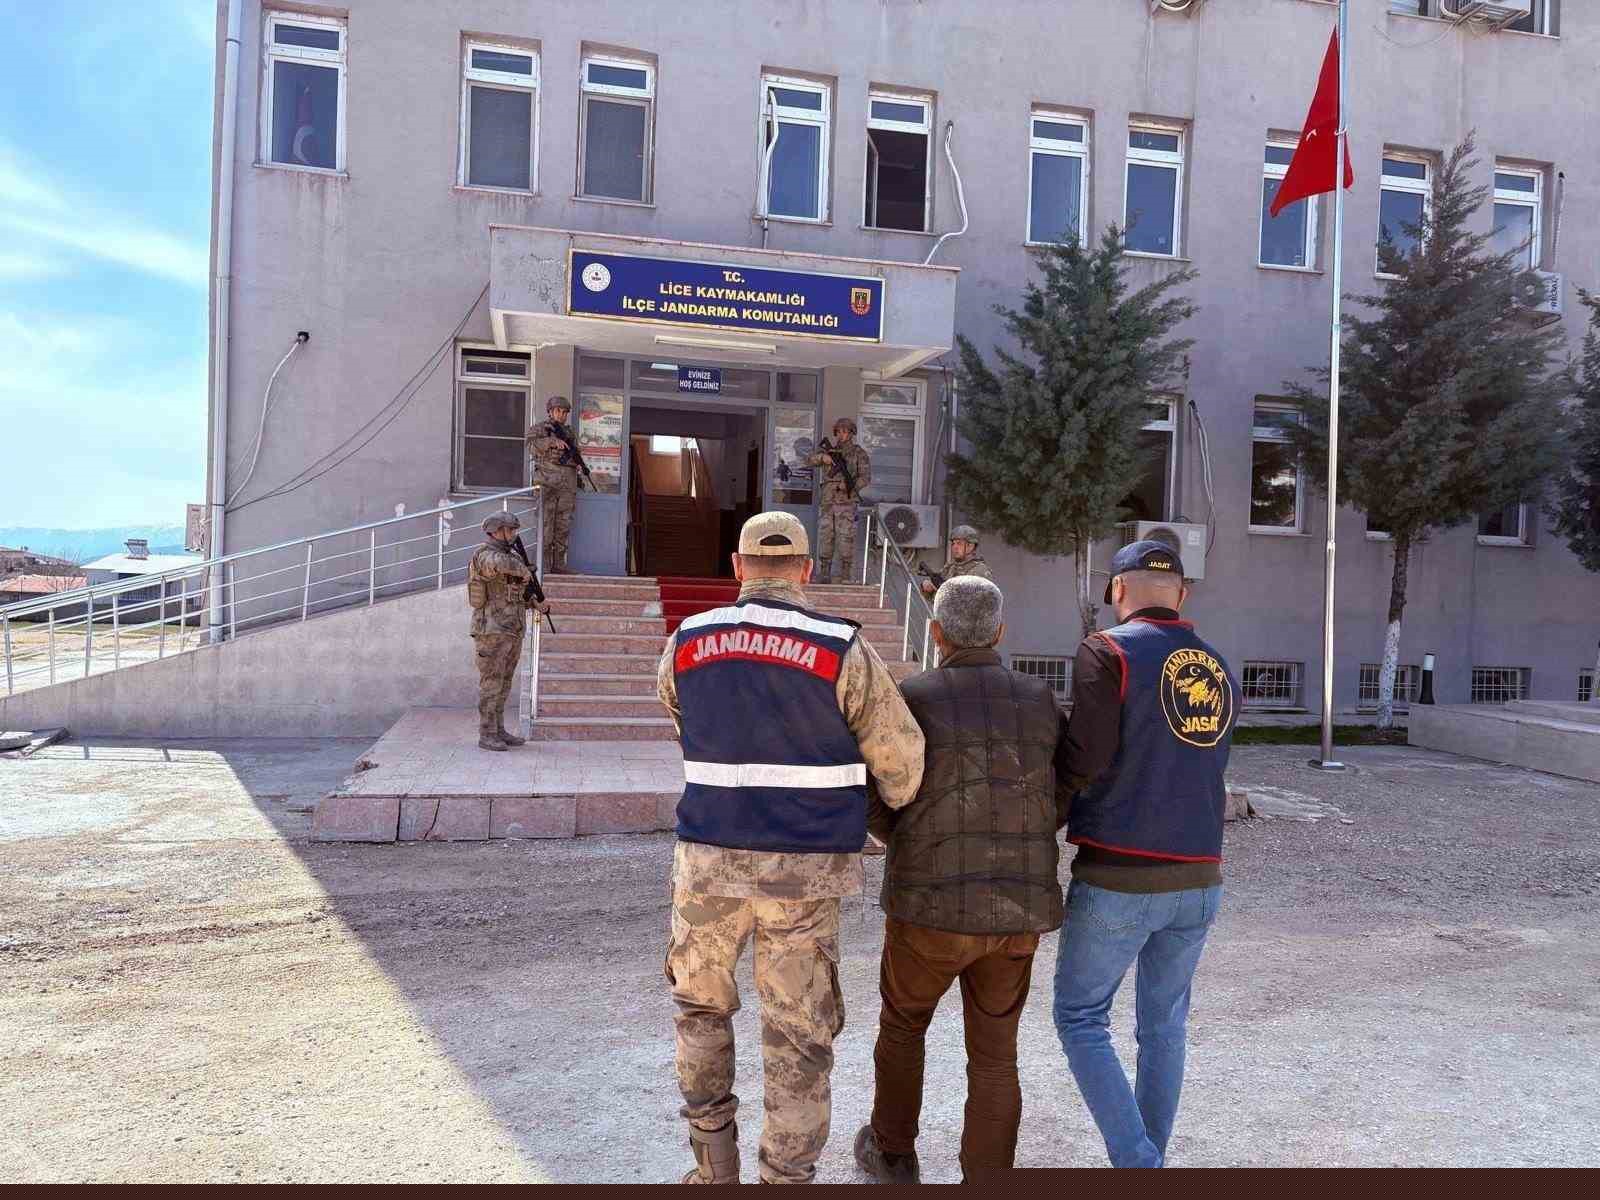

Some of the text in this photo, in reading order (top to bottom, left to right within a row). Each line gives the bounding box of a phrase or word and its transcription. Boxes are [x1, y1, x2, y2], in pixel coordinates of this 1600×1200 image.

[722, 271, 745, 283] T.C.
[660, 281, 805, 306] LİCE KAYMAKAMLIĞI
[622, 295, 838, 328] İLÇE JANDARMA KOMUTANLIĞI
[679, 379, 720, 390] HOŞ GELDİNİZ
[1148, 560, 1171, 569] JASAT
[692, 630, 818, 669] JANDARMA
[1166, 651, 1224, 682] JANDARMA
[1181, 716, 1219, 733] JASAT
